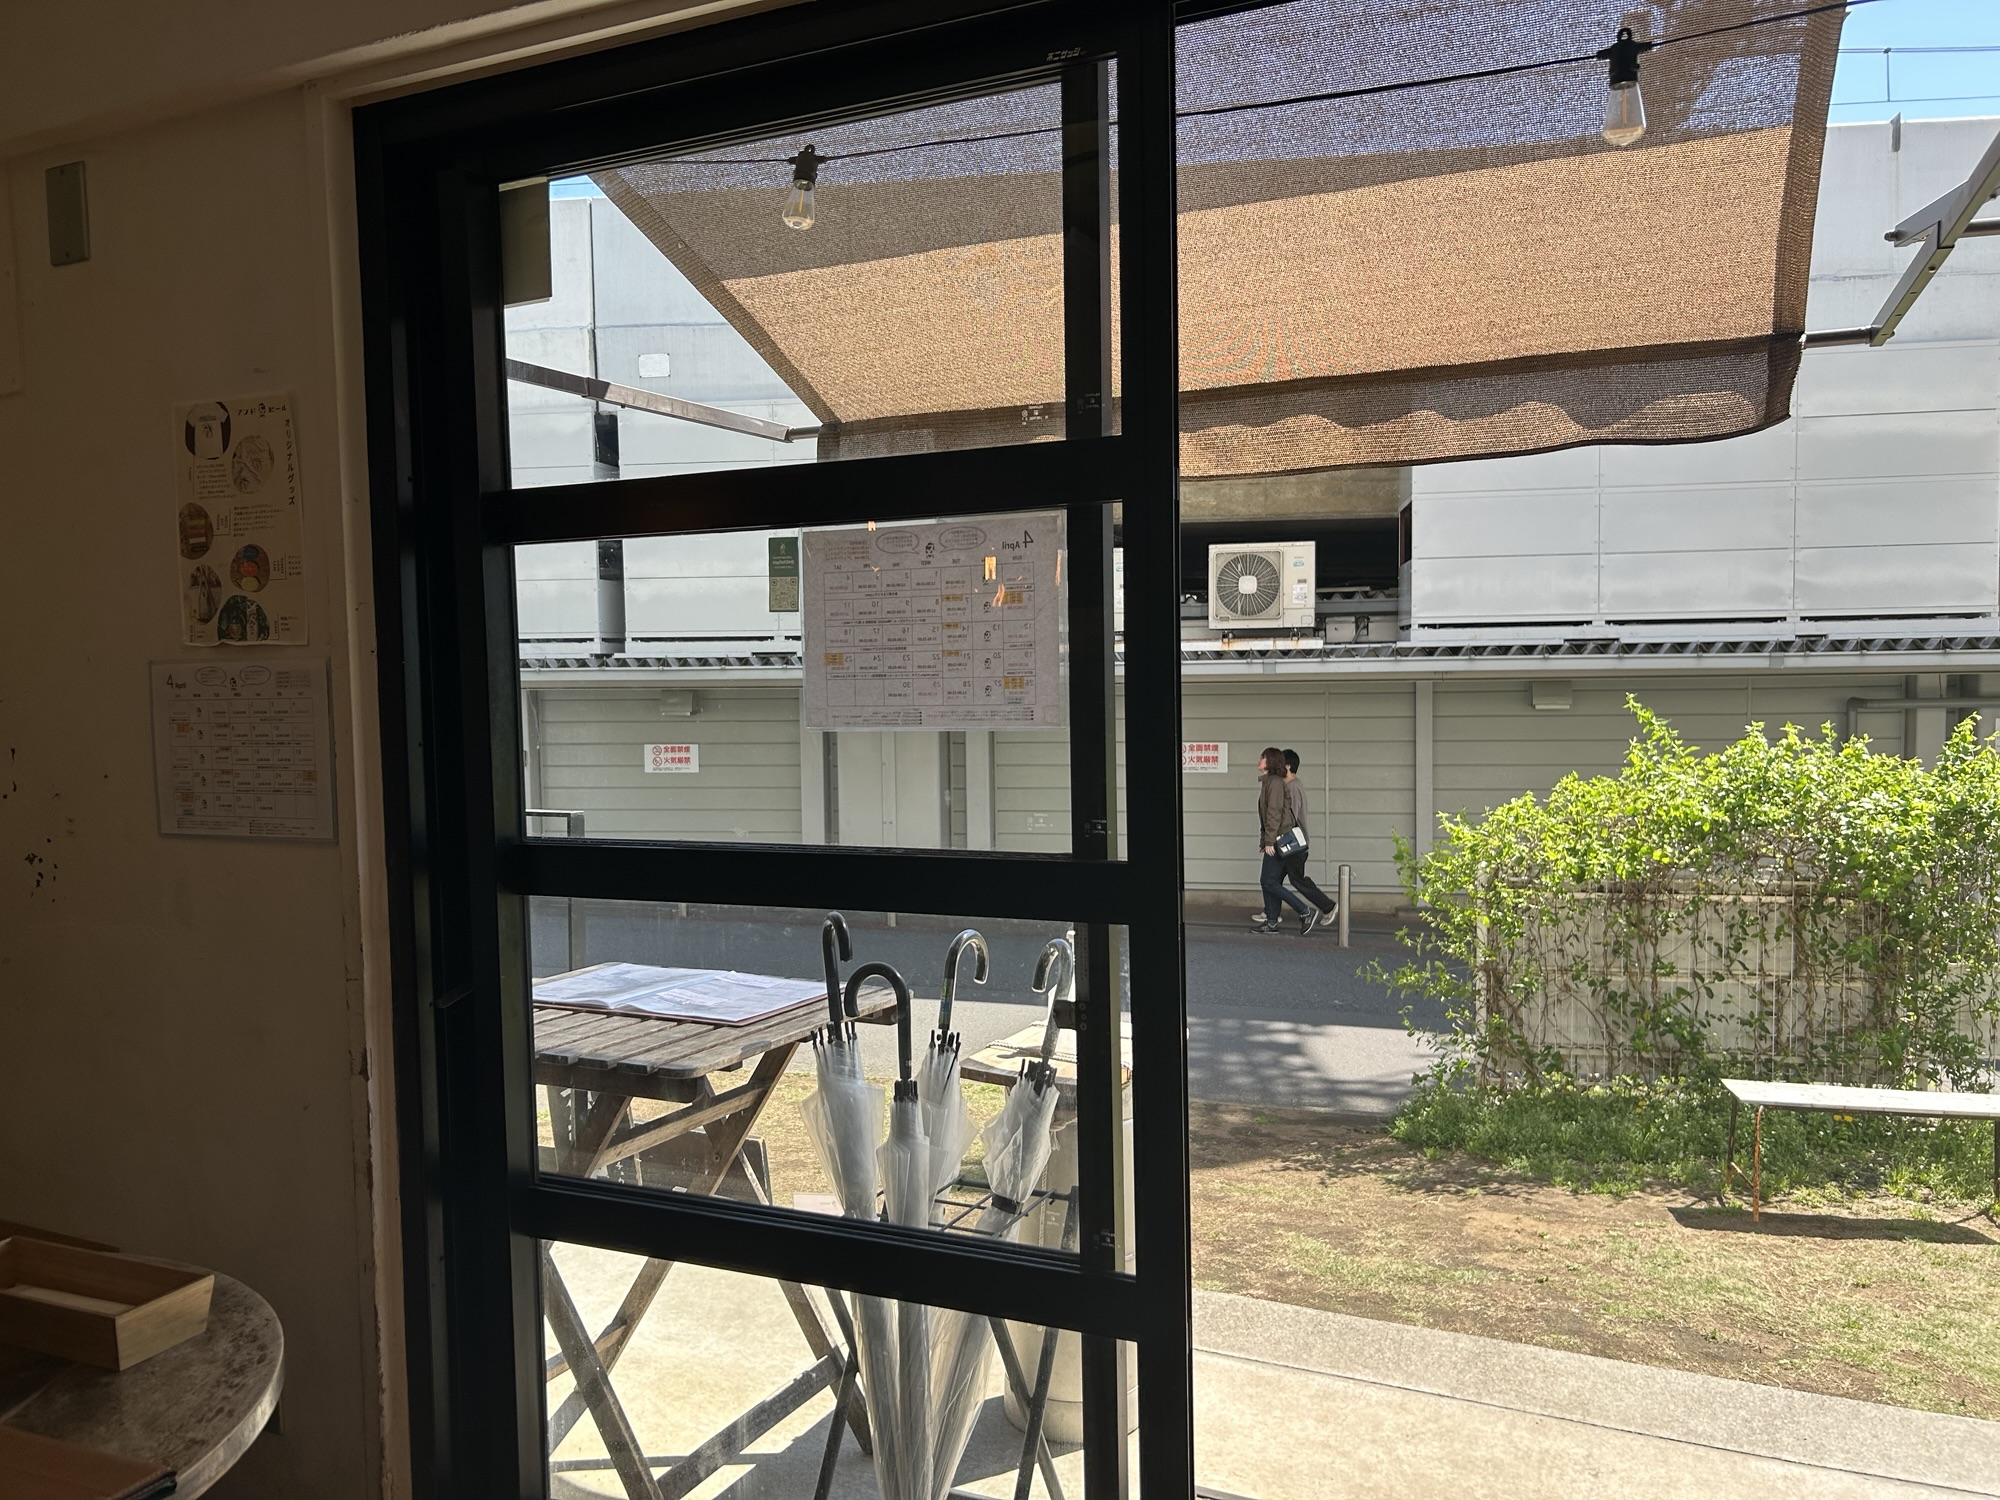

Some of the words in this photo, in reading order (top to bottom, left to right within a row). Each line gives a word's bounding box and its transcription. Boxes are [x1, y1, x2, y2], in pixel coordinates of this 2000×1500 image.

[283, 418, 296, 506] オリジナルグッズ
[166, 674, 174, 688] 4
[1188, 744, 1218, 752] 全面禁煙
